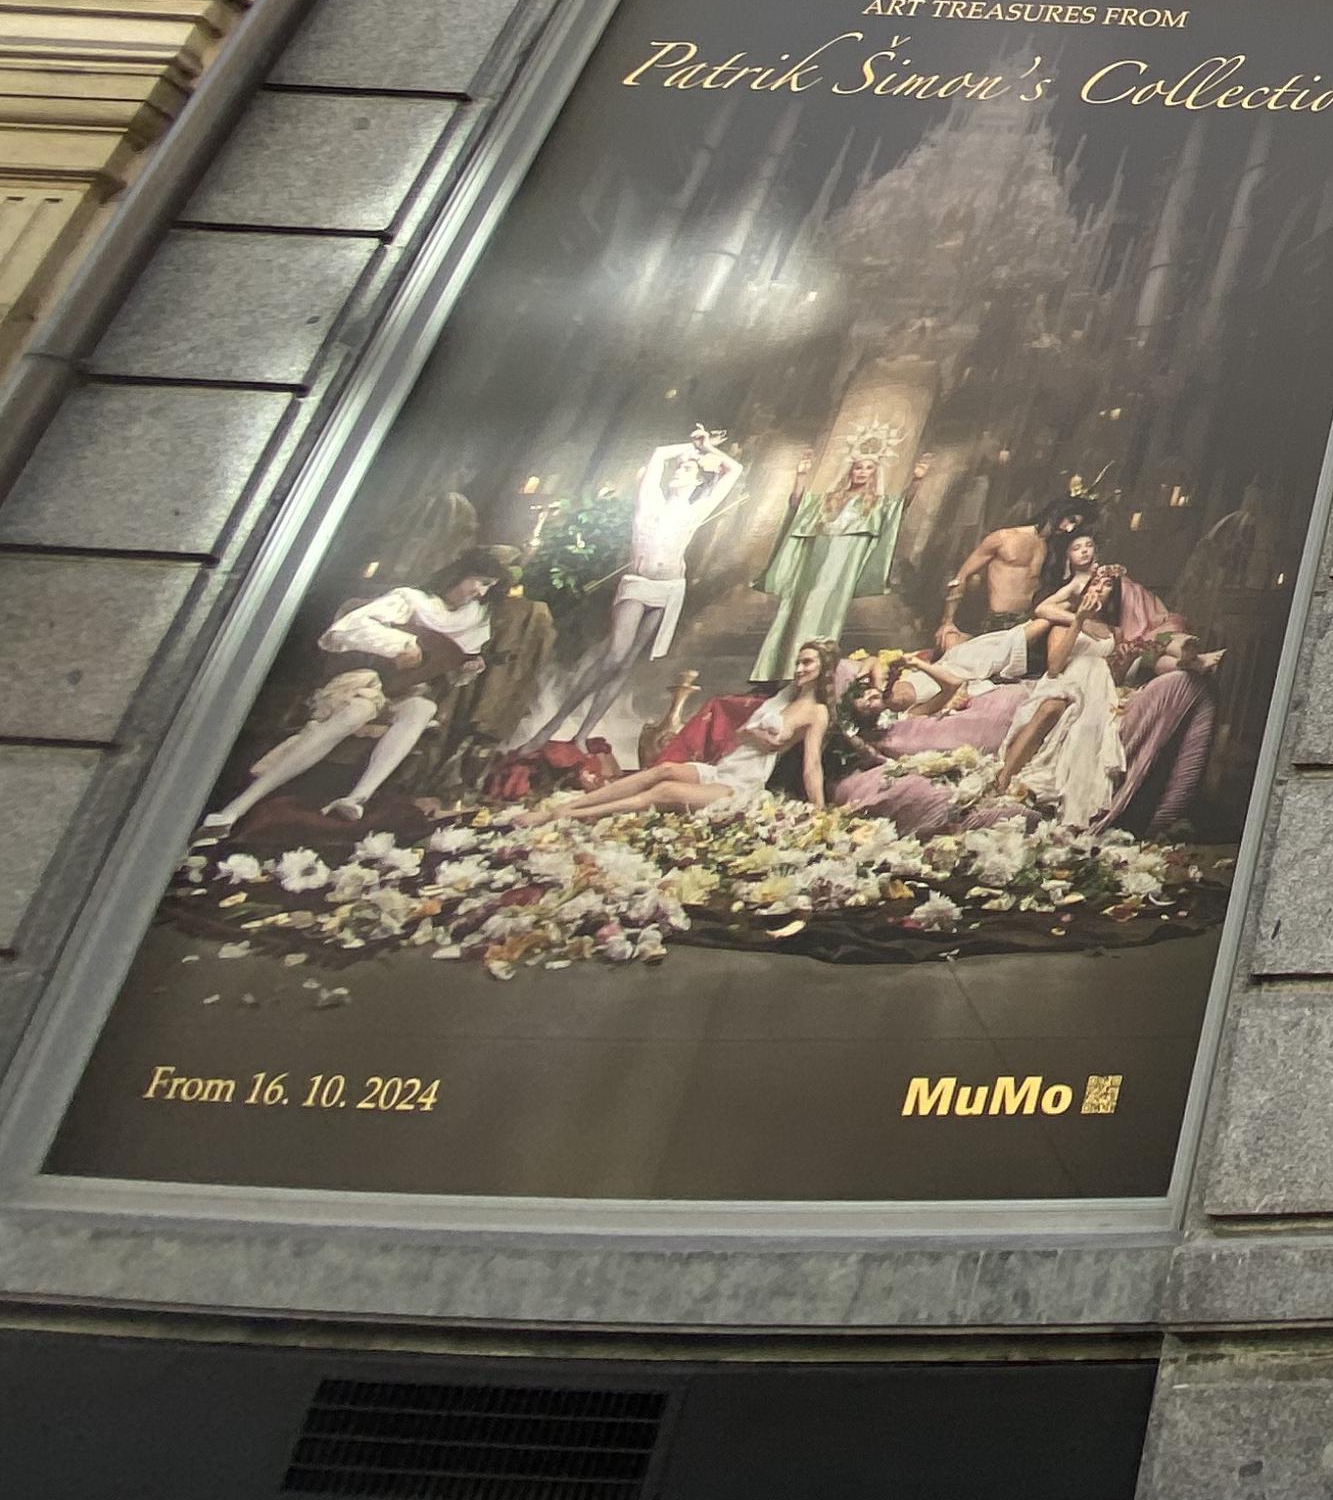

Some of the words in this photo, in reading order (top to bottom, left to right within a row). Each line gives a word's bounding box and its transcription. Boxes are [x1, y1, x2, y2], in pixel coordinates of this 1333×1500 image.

[932, 0, 1097, 25] TREASURES
[1101, 6, 1190, 28] FROM
[621, 32, 863, 93] Patrik
[143, 1065, 236, 1102] From
[245, 1071, 289, 1105] 16.
[302, 1074, 346, 1108] 10.
[356, 1076, 441, 1112] 2024
[901, 1075, 1074, 1116] MuMo
